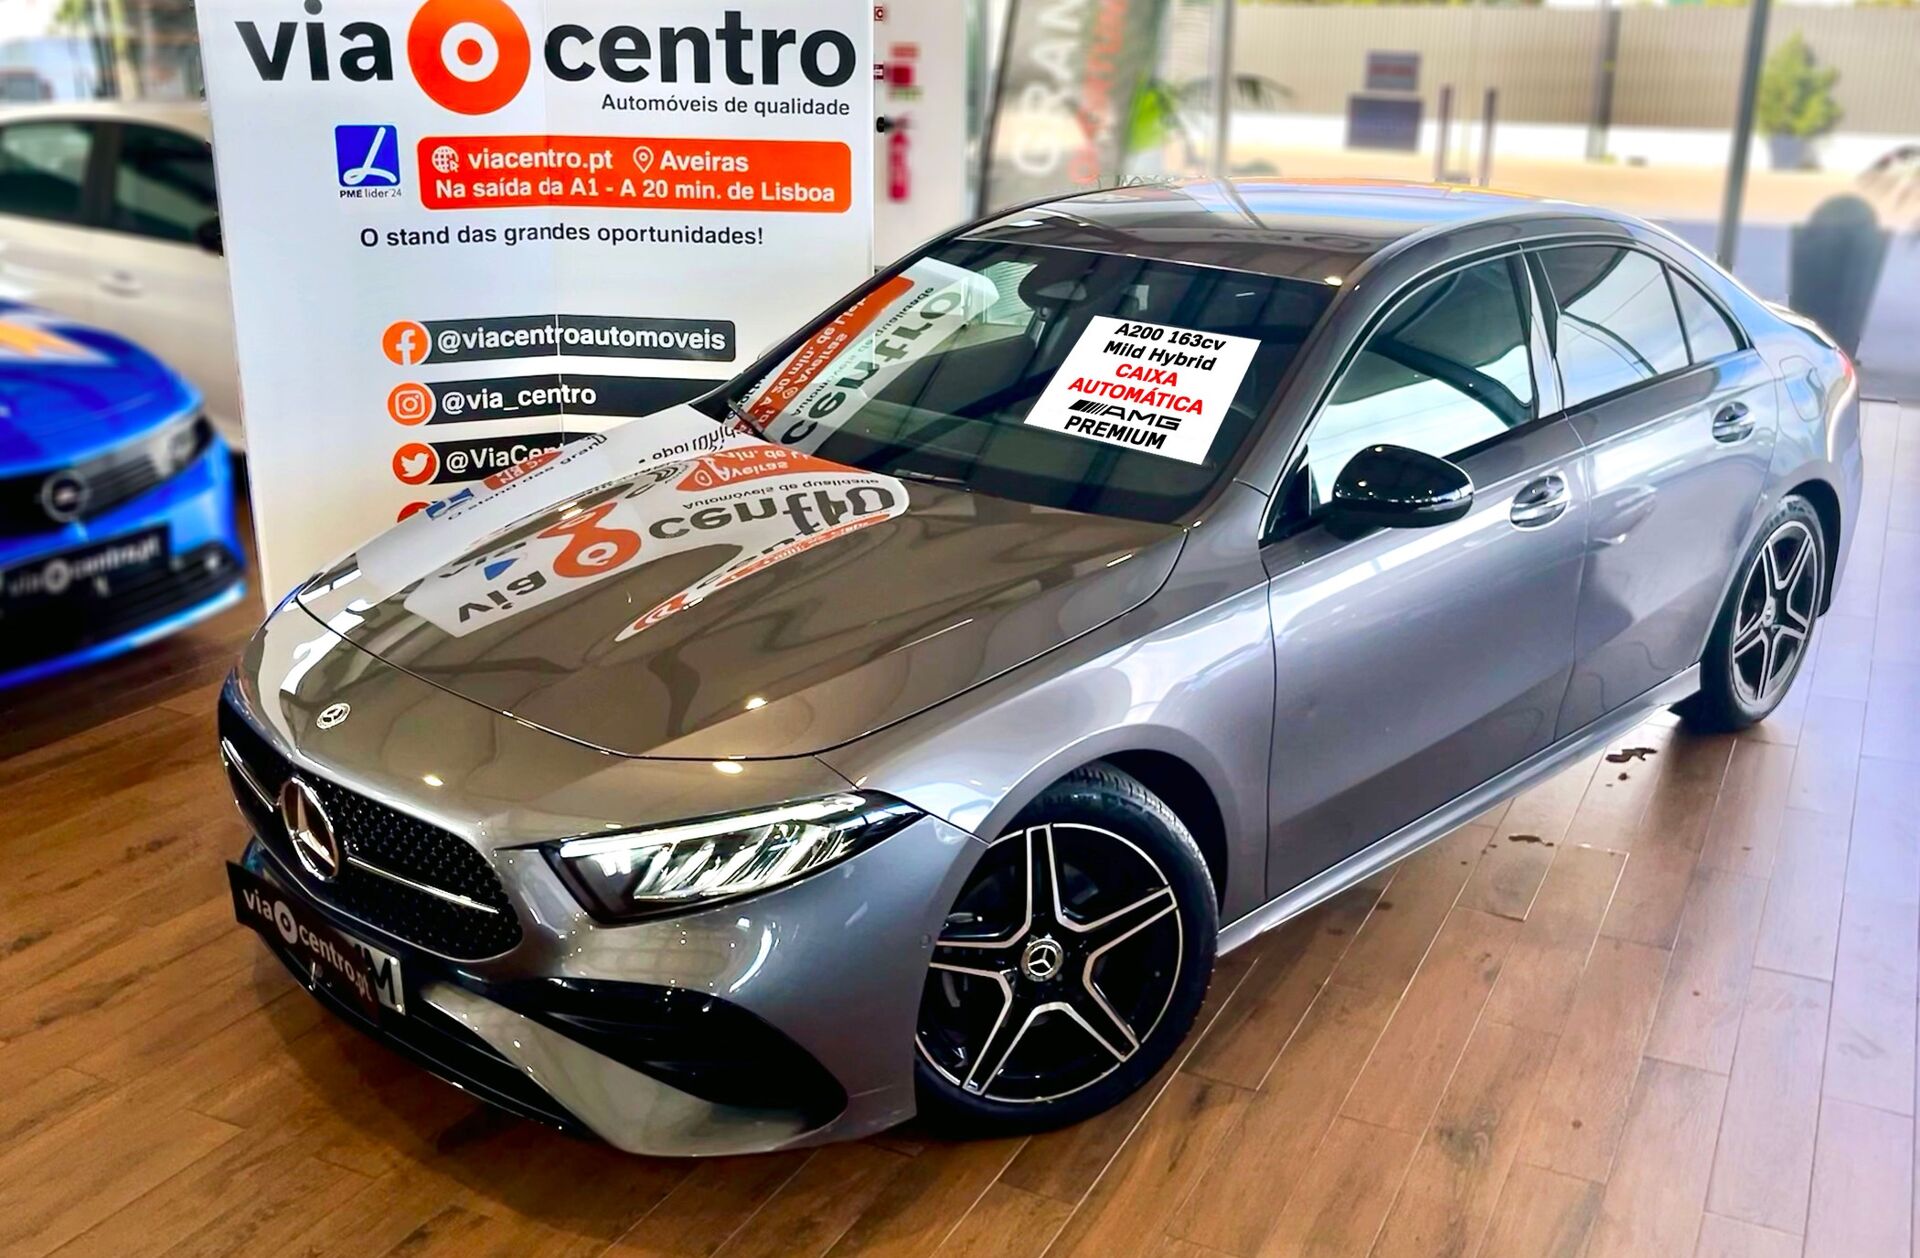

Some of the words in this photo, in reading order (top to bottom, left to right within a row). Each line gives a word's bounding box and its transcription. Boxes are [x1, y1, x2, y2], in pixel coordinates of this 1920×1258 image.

[234, 0, 394, 82] via
[544, 10, 856, 88] centro
[601, 94, 718, 112] Automóveis
[724, 97, 748, 113] de
[754, 98, 850, 118] qualidade
[467, 148, 613, 172] viacentro.pt
[659, 150, 749, 172] Aveiras
[339, 189, 363, 198] PME
[436, 179, 466, 198] Na
[473, 177, 532, 197] saída
[538, 177, 563, 196] da
[570, 177, 599, 196] A1
[620, 178, 637, 197] A
[642, 179, 668, 198] 20
[675, 180, 721, 199] min.
[727, 181, 754, 200] de
[761, 182, 835, 202] Lisboa
[360, 228, 379, 247] O
[386, 226, 450, 246] stand
[457, 225, 497, 243] das
[504, 223, 590, 245] grandes
[597, 226, 763, 246] oportunidades!
[437, 327, 726, 354] @viacentroautomoveis
[442, 383, 597, 415] @via_centro
[243, 888, 274, 922] via
